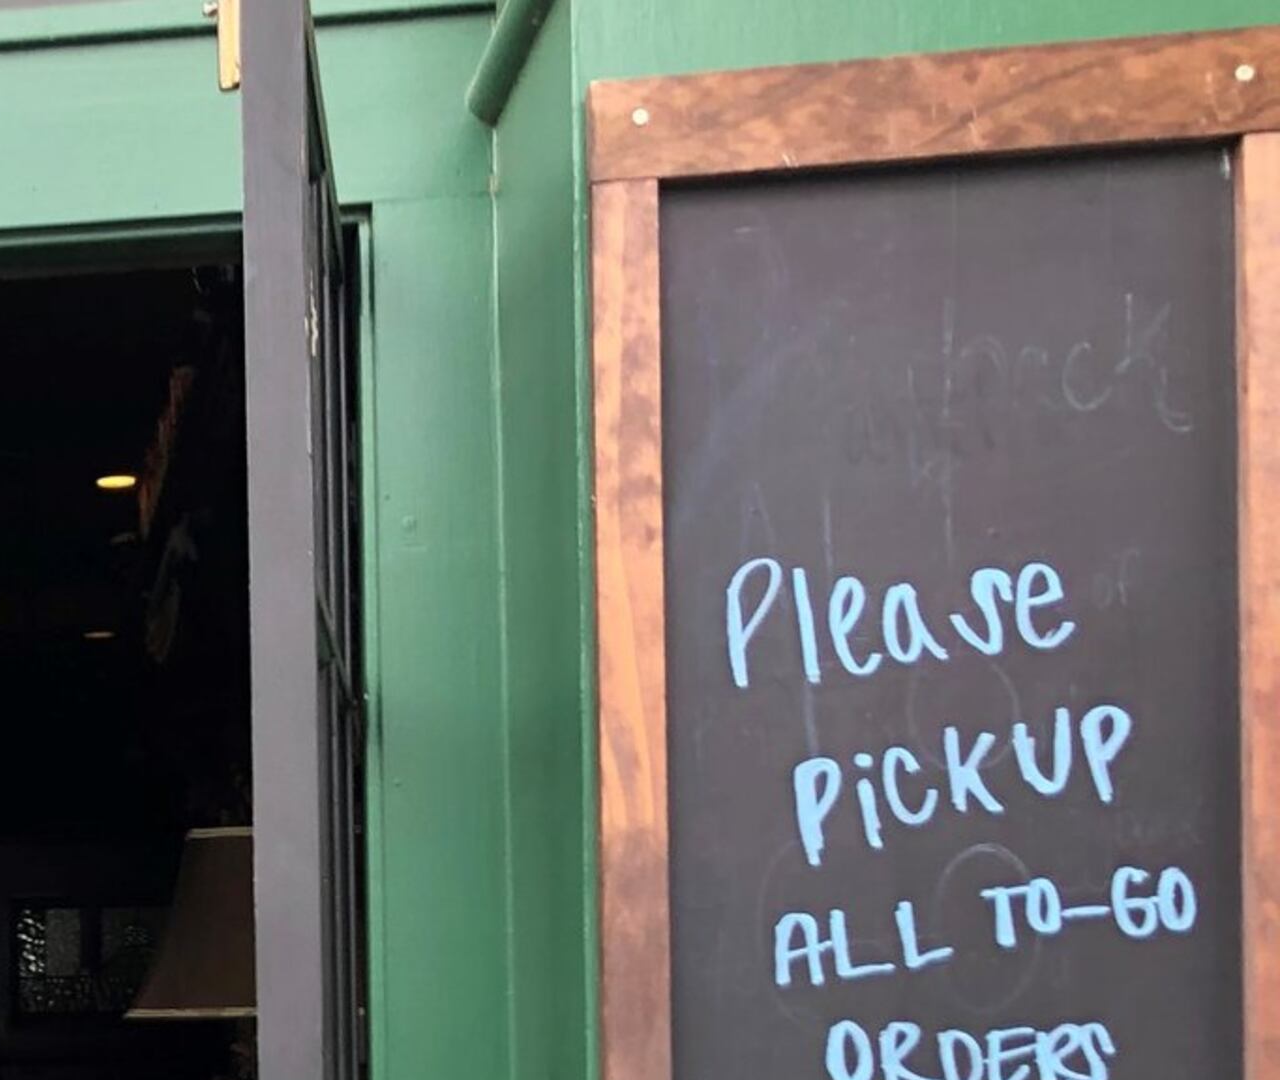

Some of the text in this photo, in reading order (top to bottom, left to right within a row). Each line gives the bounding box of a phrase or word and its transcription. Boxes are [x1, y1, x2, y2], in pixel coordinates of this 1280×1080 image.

[726, 557, 1076, 688] Please
[774, 866, 1197, 986] ALL TO-GO
